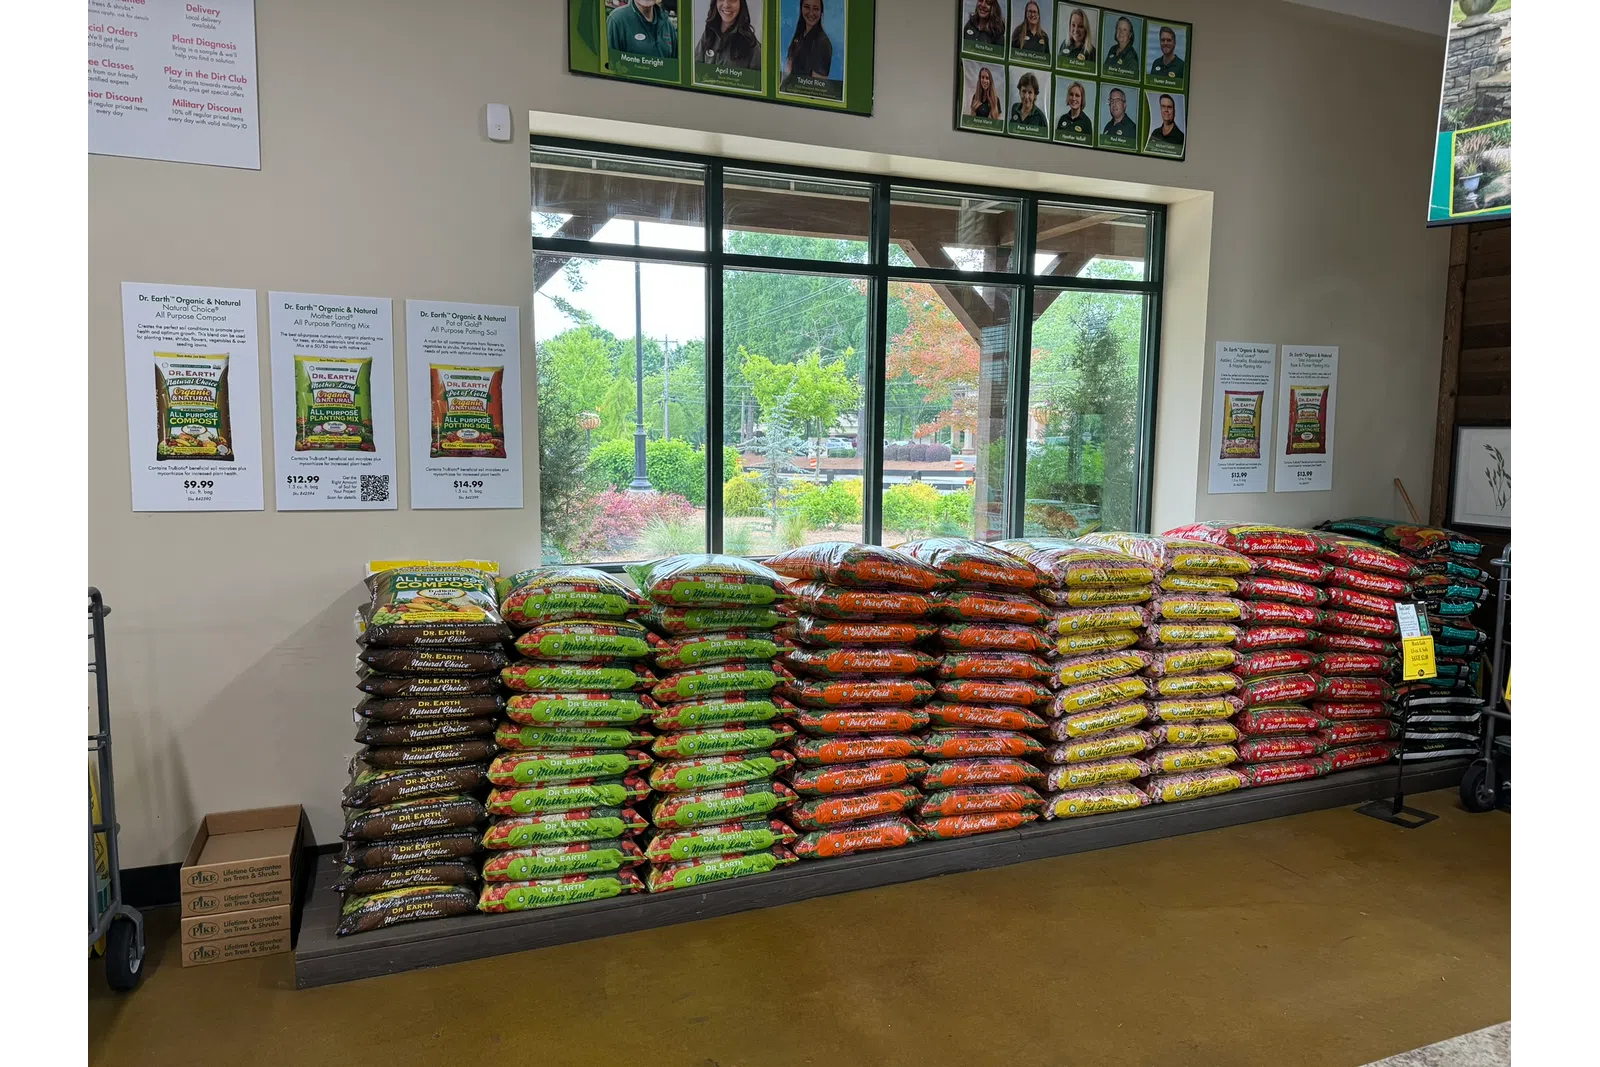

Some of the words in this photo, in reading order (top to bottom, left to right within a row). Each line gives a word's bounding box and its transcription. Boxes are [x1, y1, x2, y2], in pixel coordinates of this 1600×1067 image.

[186, 4, 220, 17] Delivery
[201, 16, 221, 24] delivery
[107, 26, 138, 37] Orders
[172, 34, 193, 45] Plant
[196, 38, 237, 50] Diagnosis
[175, 52, 187, 60] help
[200, 49, 218, 57] sample
[102, 59, 134, 70] Classes
[621, 54, 640, 64] Monte
[642, 56, 664, 66] Enright
[118, 72, 138, 80] friendly
[164, 66, 182, 78] Play
[185, 69, 192, 77] in
[194, 70, 208, 78] the
[211, 72, 226, 81] Dirt
[228, 75, 247, 84] Club
[715, 66, 728, 76] April
[729, 68, 742, 77] Hoyt
[183, 79, 199, 87] points
[200, 80, 220, 88] towards
[797, 76, 812, 86] Taylor
[813, 78, 826, 87] Rice
[211, 88, 229, 96] special
[106, 92, 143, 103] Discount
[172, 98, 205, 111] Military
[207, 102, 242, 114] Discount
[194, 111, 212, 119] regular
[213, 112, 229, 121] priced
[222, 121, 240, 130] military
[176, 297, 204, 305] Organic
[319, 305, 344, 313] Organic
[167, 312, 194, 320] Purpose
[196, 313, 226, 322] Compost
[452, 313, 476, 321] Organic
[305, 320, 329, 328] Purpose
[331, 321, 355, 330] Planting
[441, 327, 464, 335] Purpose
[465, 328, 484, 336] Potting
[184, 480, 214, 489] $9.99
[287, 475, 319, 484] $12.99
[395, 581, 485, 591] COMPOST
[560, 854, 588, 862] EARTH
[223, 868, 247, 876] Lifetime
[249, 864, 282, 873] Guarantee
[531, 864, 569, 874] Mother
[572, 859, 600, 870] Land
